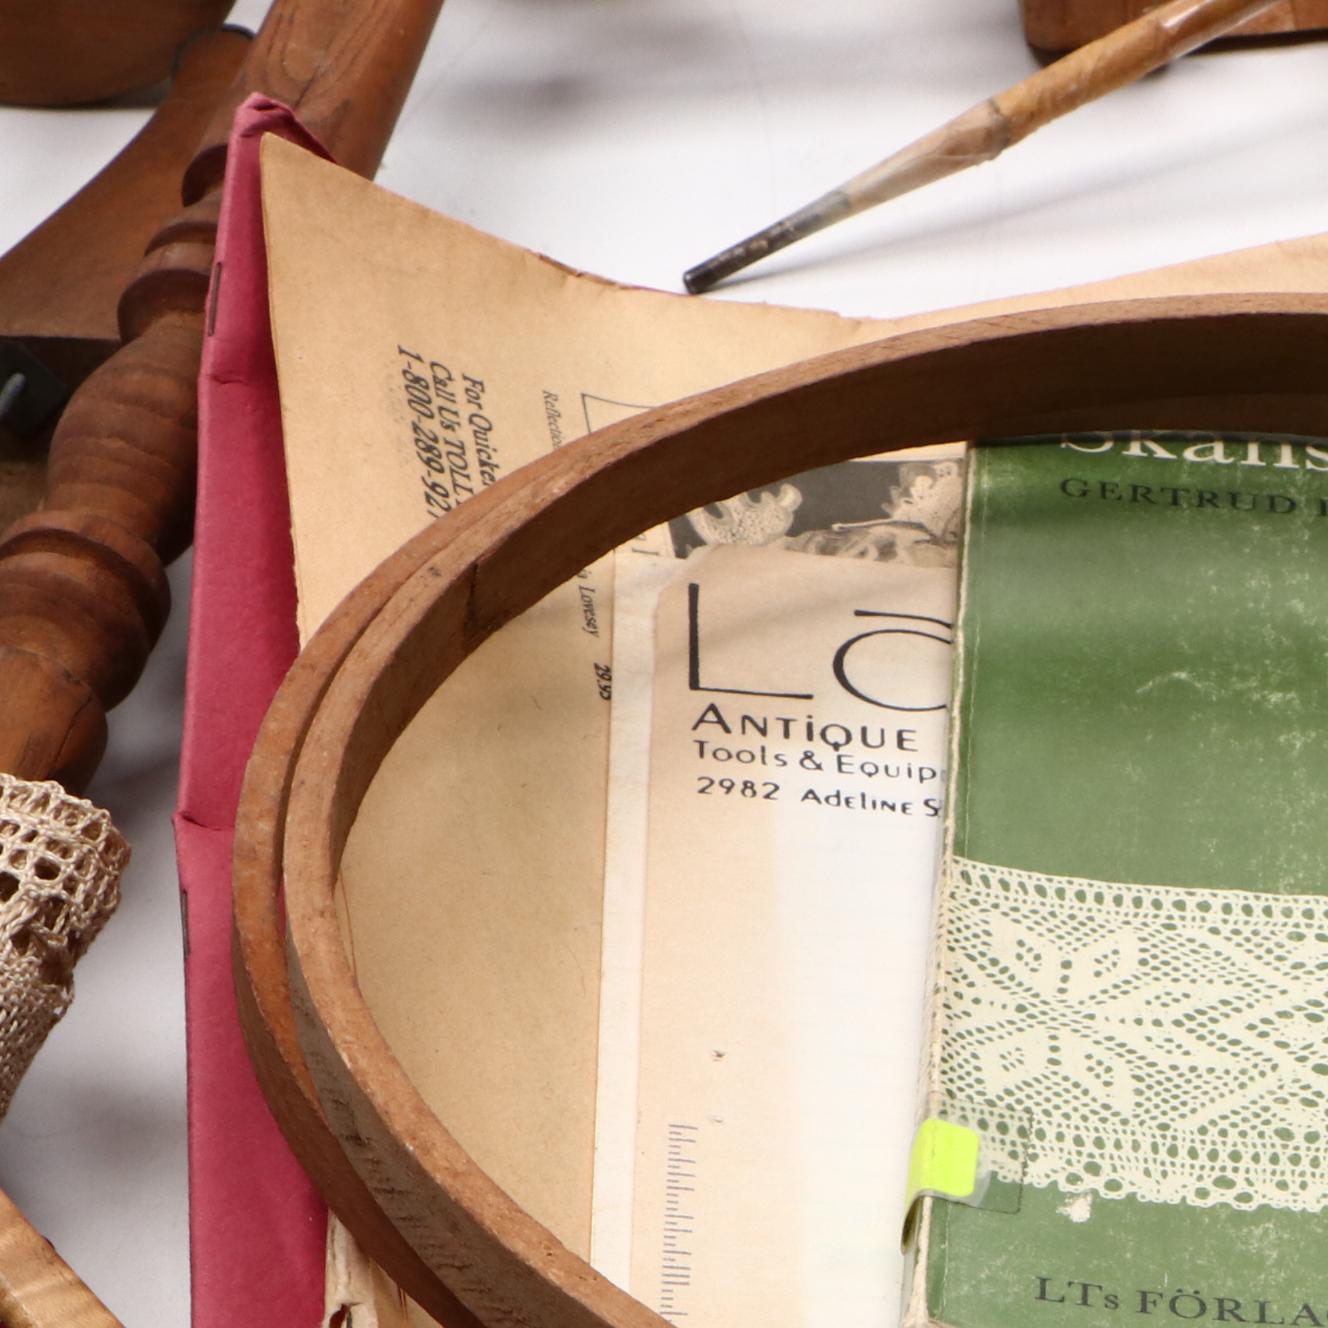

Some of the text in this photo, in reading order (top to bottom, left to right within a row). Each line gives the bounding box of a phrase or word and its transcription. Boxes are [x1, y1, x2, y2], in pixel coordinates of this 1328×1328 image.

[461, 372, 486, 411] For
[430, 361, 474, 496] Call Us TOLL
[1060, 477, 1297, 514] GERTRUD
[578, 584, 600, 638] Lovesey
[693, 739, 946, 784] Tools & Equip
[696, 777, 781, 801] 2982
[1034, 1276, 1120, 1311] LTs
